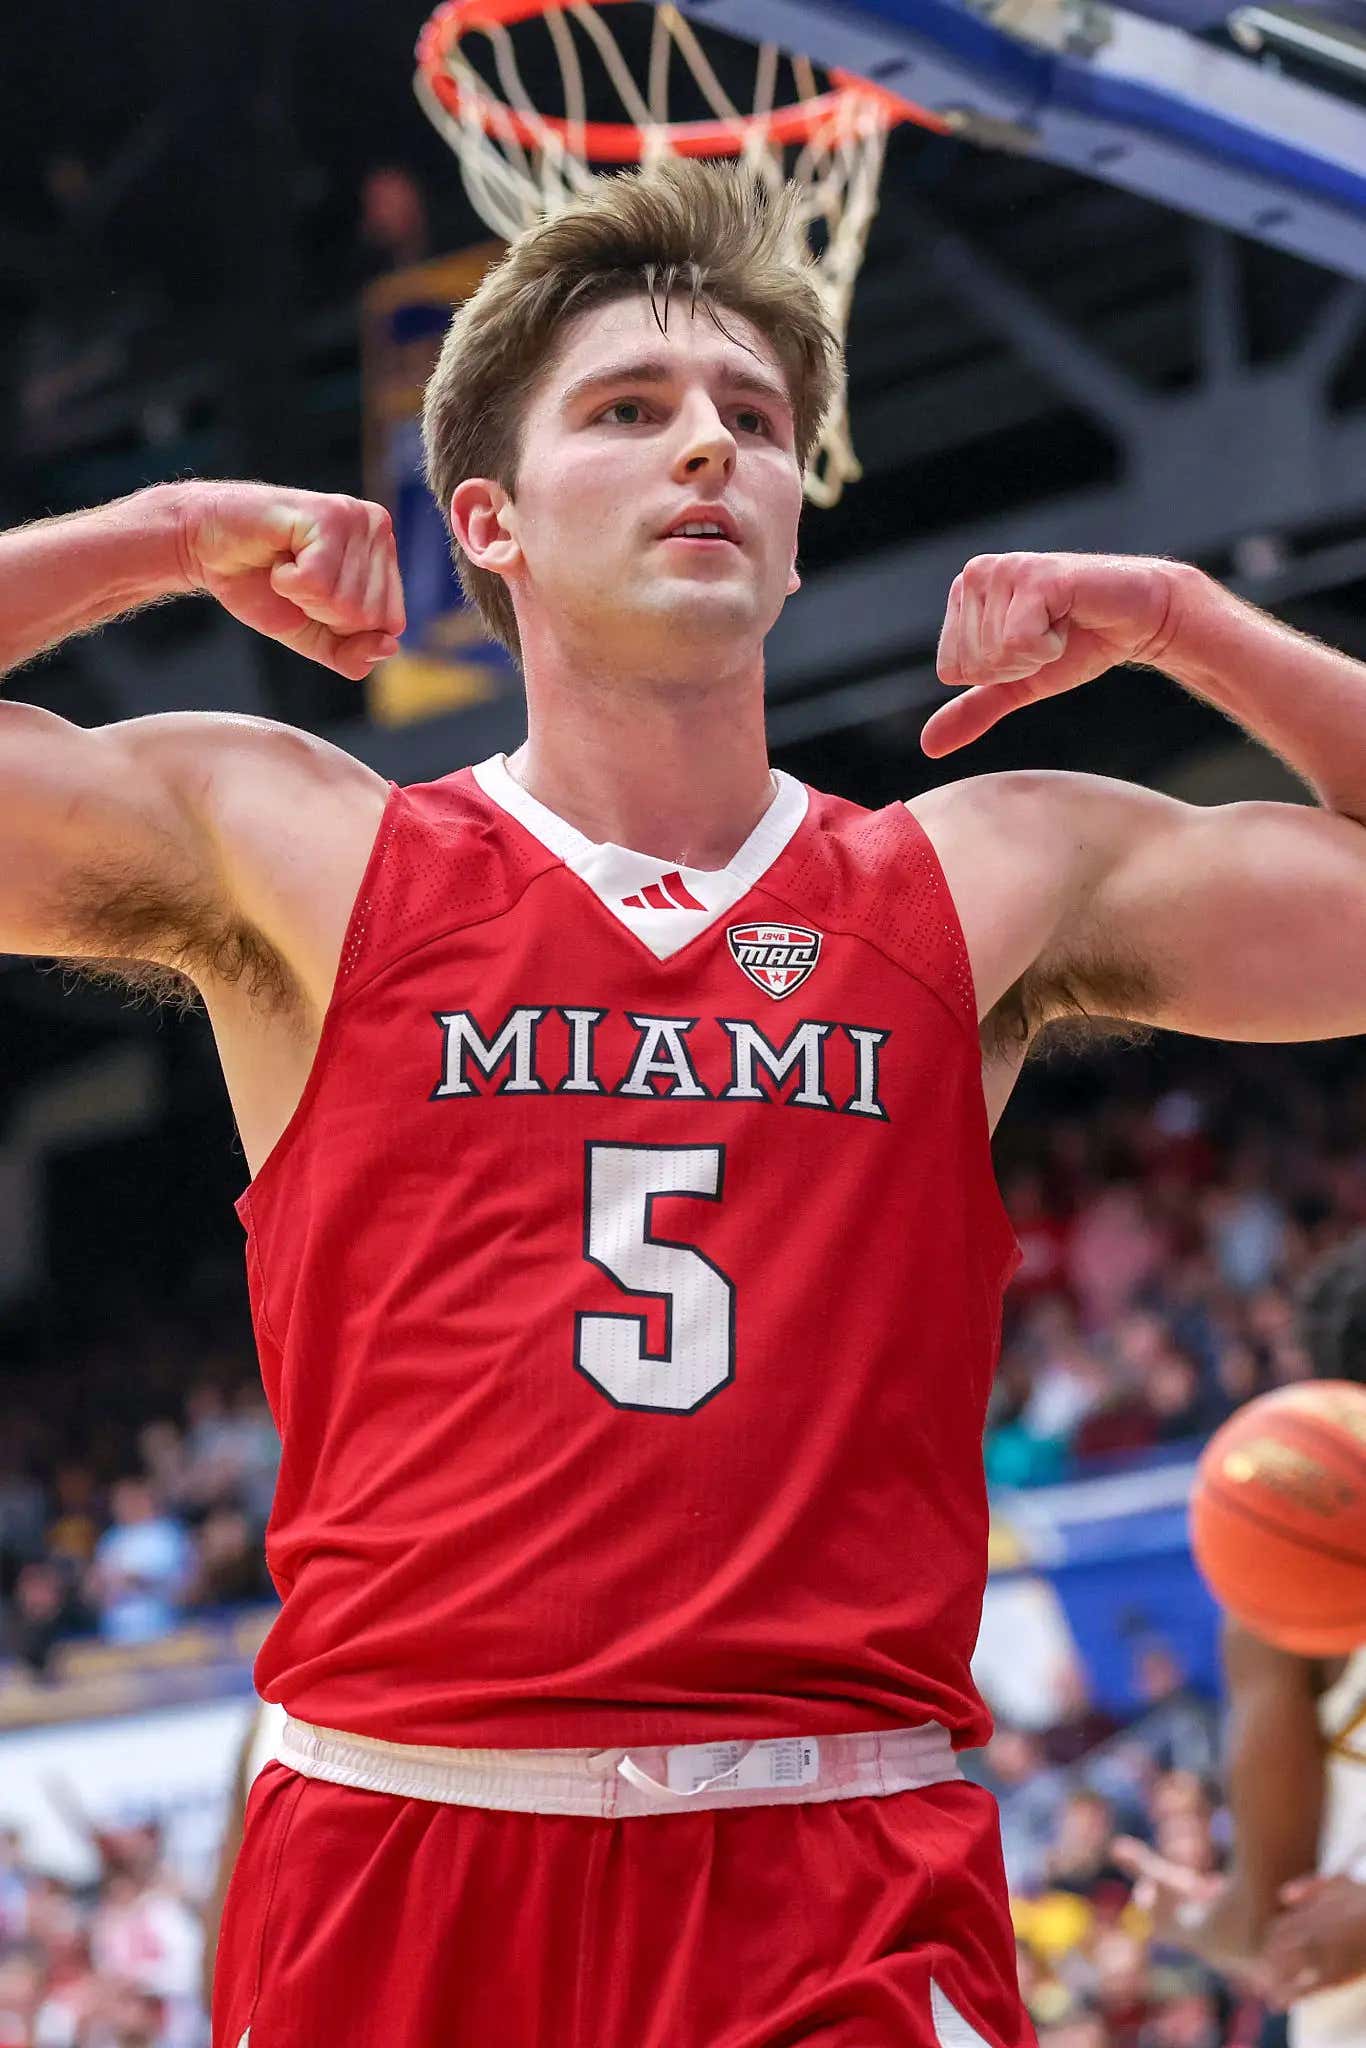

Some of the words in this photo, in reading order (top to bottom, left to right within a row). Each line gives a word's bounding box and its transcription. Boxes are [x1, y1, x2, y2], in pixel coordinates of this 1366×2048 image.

[738, 946, 815, 966] MAC
[430, 1007, 891, 1121] MIAMI
[574, 1142, 735, 1415] 5
